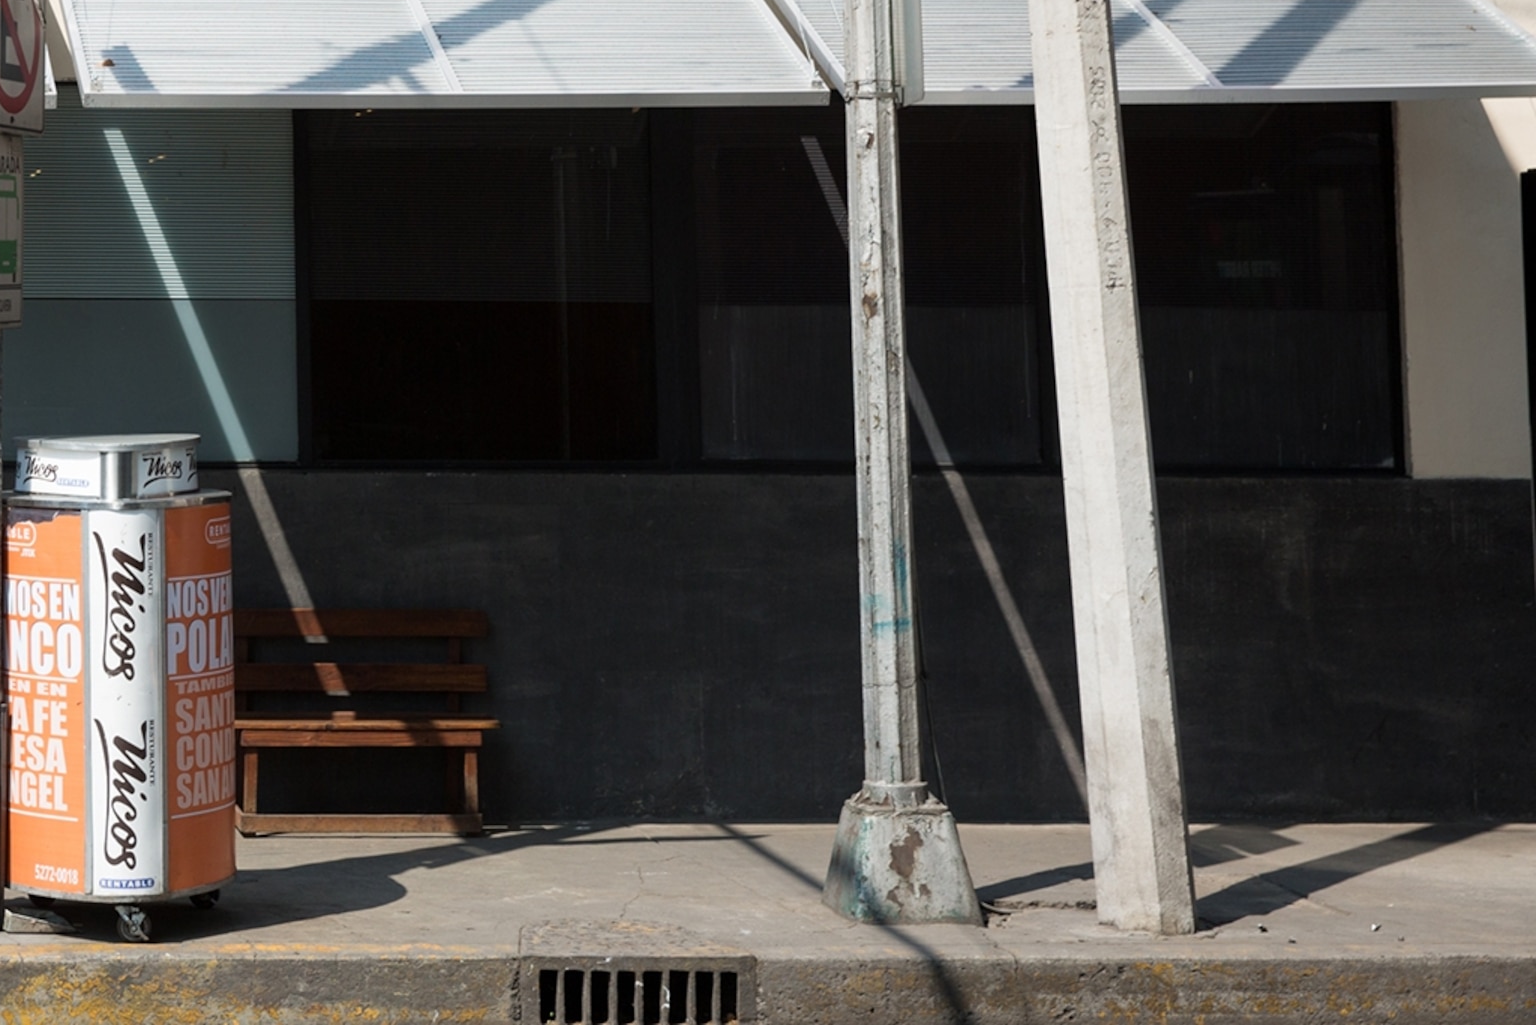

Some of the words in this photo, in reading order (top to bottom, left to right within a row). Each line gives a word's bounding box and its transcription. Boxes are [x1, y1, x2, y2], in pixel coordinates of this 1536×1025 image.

[5, 580, 46, 619] MOS
[49, 583, 80, 621] EN
[167, 580, 208, 619] NOS
[7, 620, 82, 678] NCO
[167, 614, 233, 675] POLA
[8, 678, 31, 693] EN
[36, 682, 67, 697] EN
[175, 672, 234, 694] TAMBIE
[33, 699, 68, 737] FE
[175, 688, 235, 734] SANT
[13, 733, 67, 774] ESA
[176, 727, 235, 771] COND
[9, 770, 68, 812] NGEL
[177, 768, 220, 809] SAN
[101, 879, 153, 888] RENTABLE
